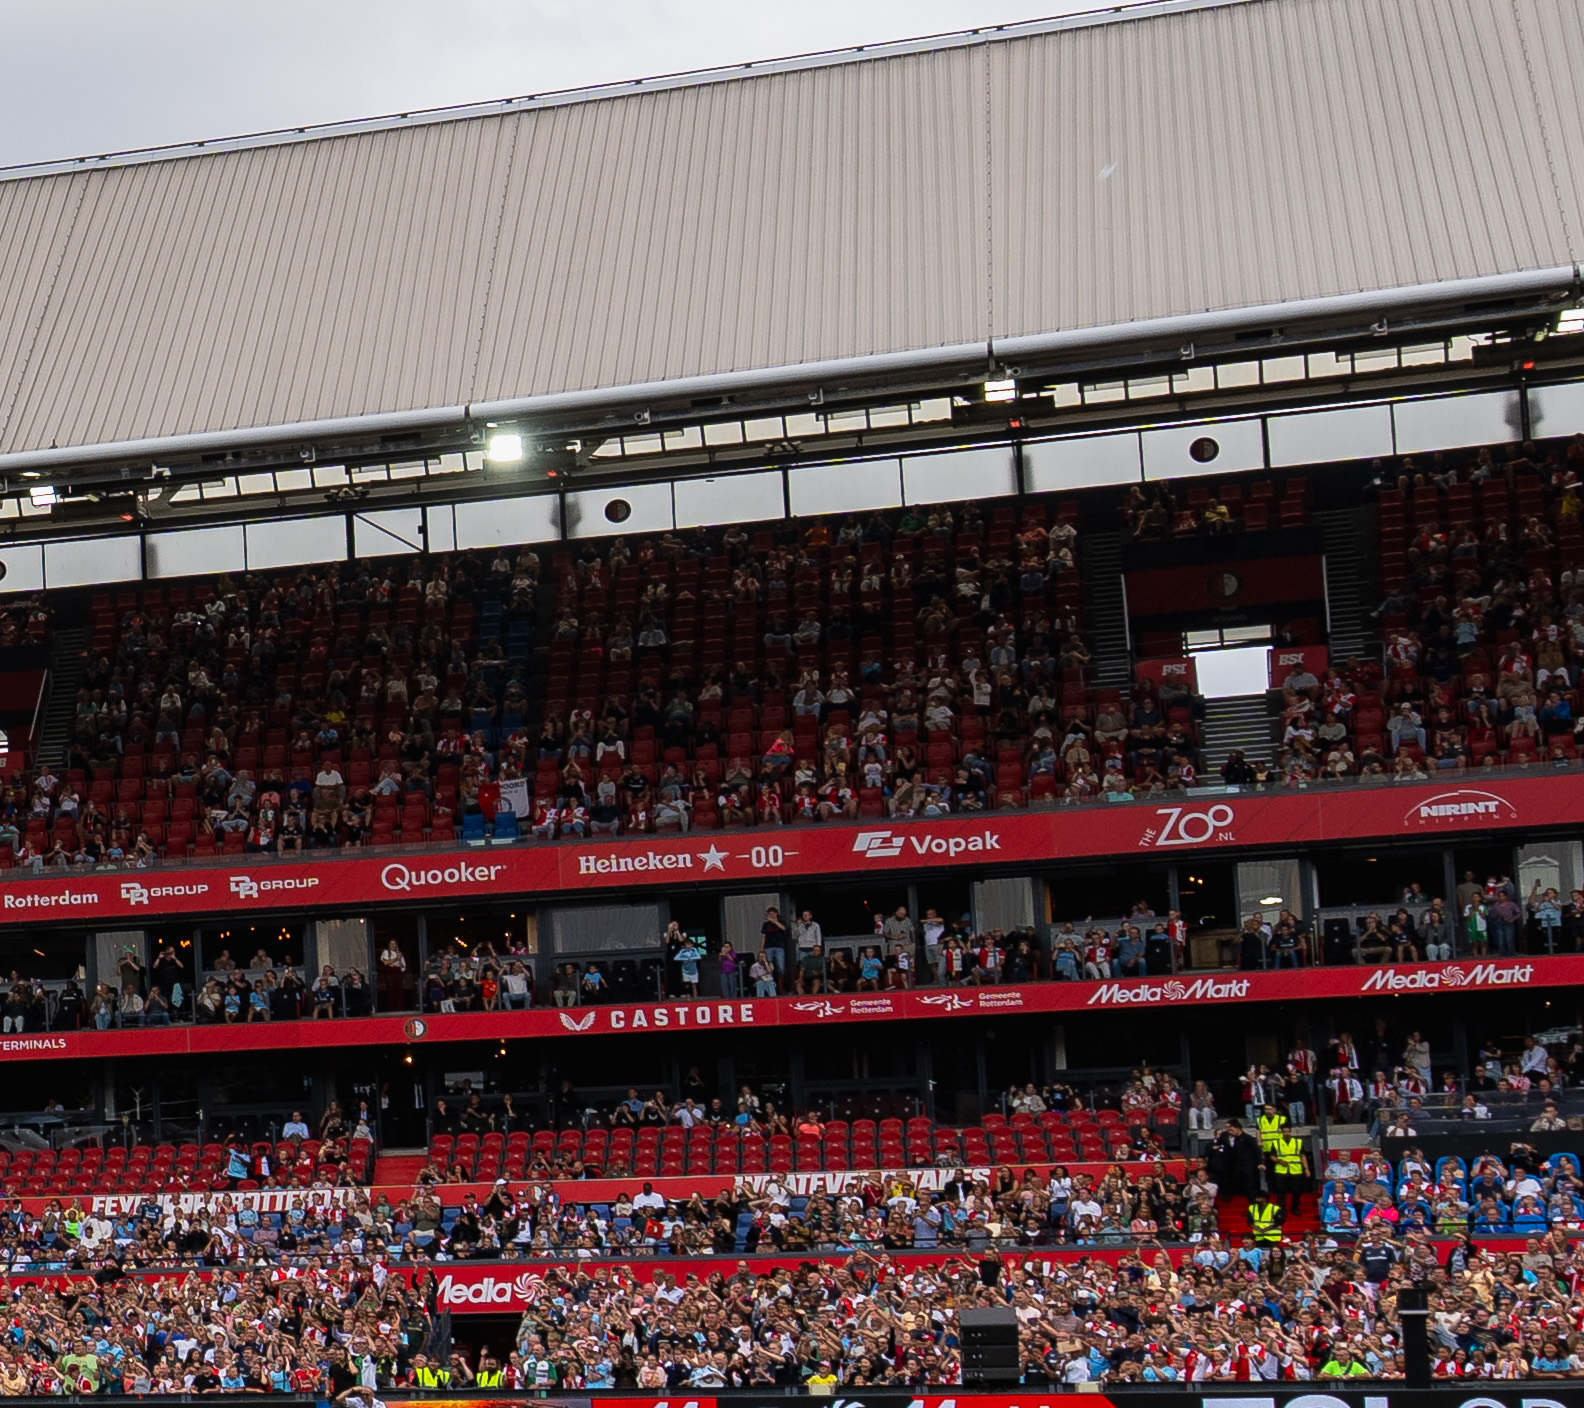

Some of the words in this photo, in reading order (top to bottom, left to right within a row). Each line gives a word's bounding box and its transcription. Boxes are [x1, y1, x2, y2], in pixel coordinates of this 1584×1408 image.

[1419, 800, 1500, 817] NIRINT
[909, 830, 1001, 859] Vopak
[1139, 828, 1158, 848] THE
[578, 853, 693, 873] Heineken
[260, 878, 320, 891] GROUP
[380, 862, 502, 891] Quooker
[4, 890, 99, 911] Rotterdam
[151, 884, 209, 897] GROUP
[609, 1003, 754, 1029] CASTORE
